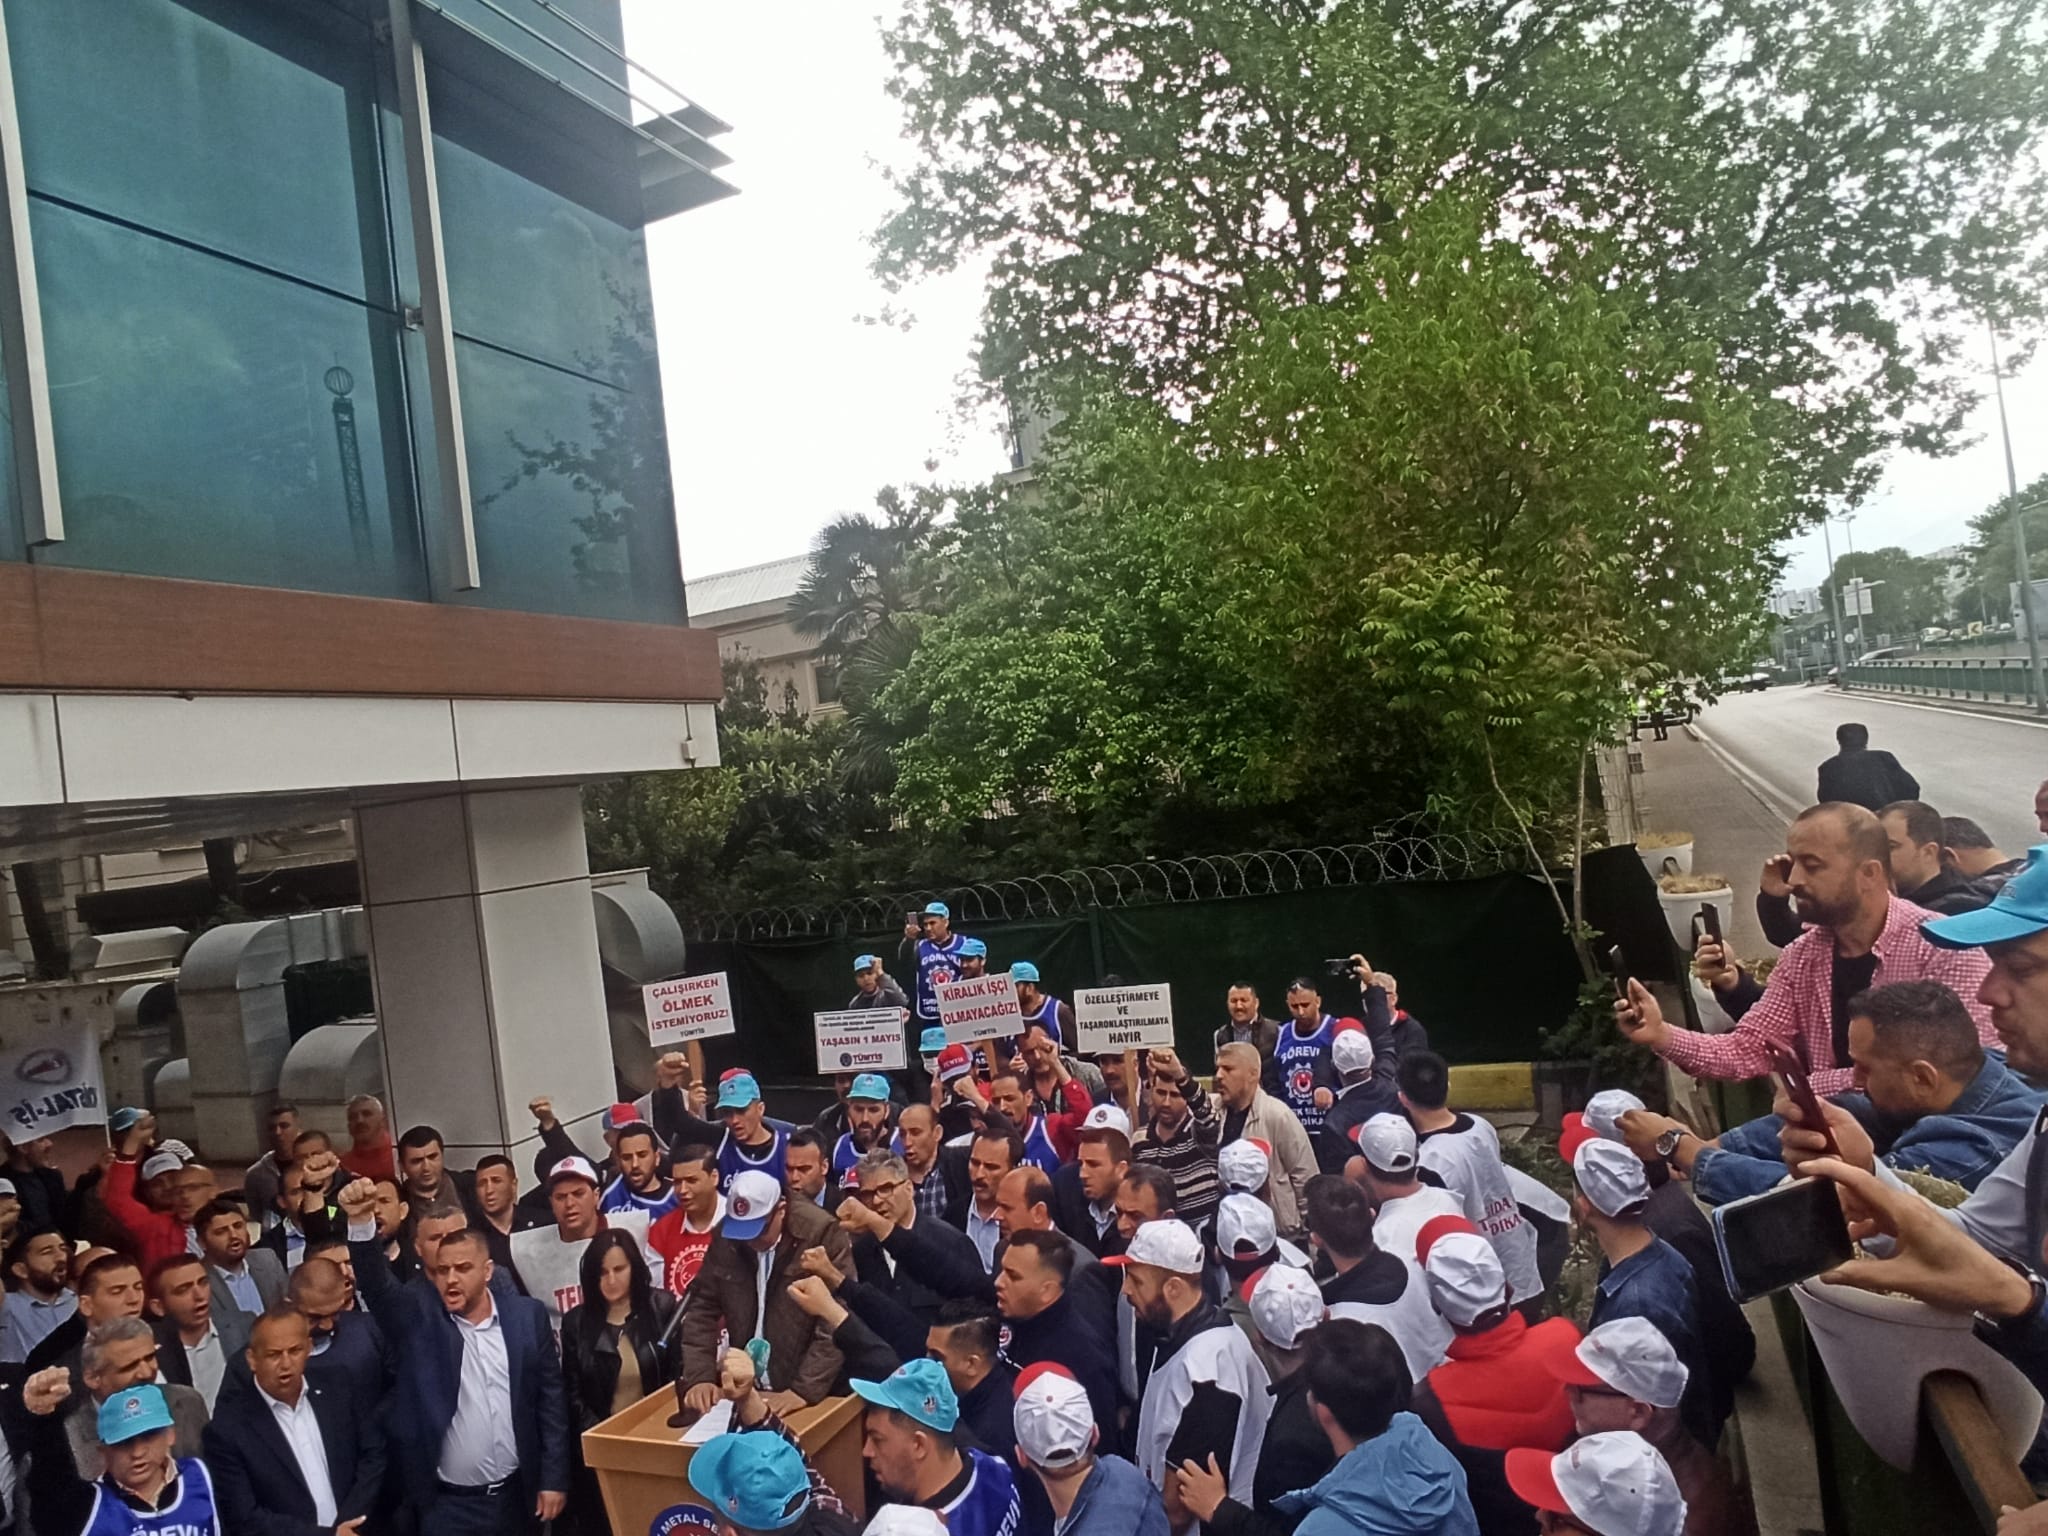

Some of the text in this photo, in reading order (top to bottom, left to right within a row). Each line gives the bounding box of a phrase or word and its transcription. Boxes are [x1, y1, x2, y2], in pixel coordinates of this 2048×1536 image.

[652, 978, 719, 999] ÇALIŞIRKEN
[942, 977, 1008, 1002] KİRALIK İŞÇİ
[1084, 991, 1160, 1006] ÖZELLEŞTİRMEYE
[662, 994, 714, 1014] ÖLMEK
[943, 1002, 1018, 1025] OLMAYACAĞIZ!
[1117, 1006, 1128, 1015] VE
[651, 1009, 729, 1031] İSTEMİYORUZ!
[1080, 1016, 1169, 1032] TAŞARONLAŞTIRILMAYA
[821, 1034, 901, 1047] YAŞASIN 1 MAYIS
[1109, 1031, 1142, 1044] HAYIR
[660, 1513, 700, 1534] METAL
